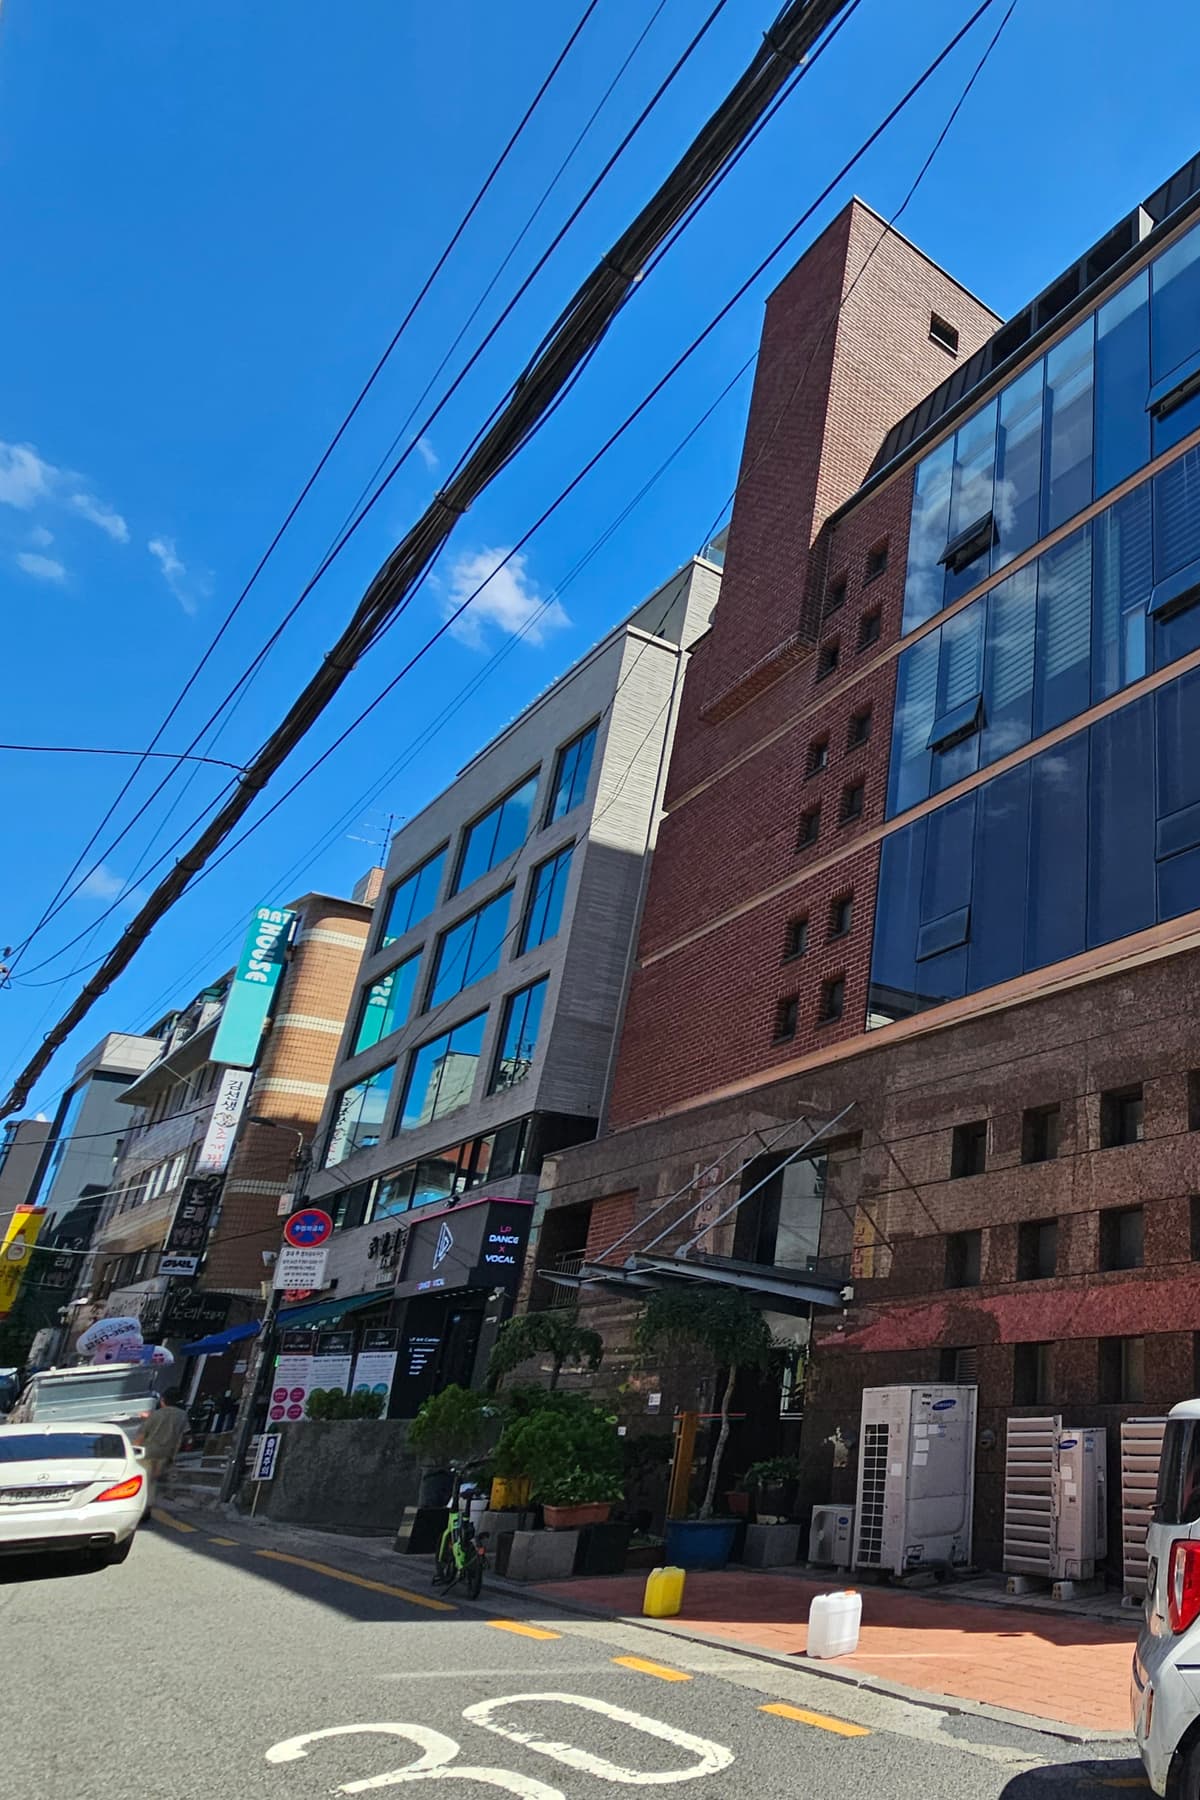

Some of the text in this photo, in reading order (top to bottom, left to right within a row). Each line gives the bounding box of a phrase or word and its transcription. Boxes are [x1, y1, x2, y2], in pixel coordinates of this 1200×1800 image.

[257, 907, 291, 925] ART
[244, 921, 283, 983] HOUSE
[488, 1234, 520, 1245] DANCE
[485, 1254, 516, 1264] VOCAL
